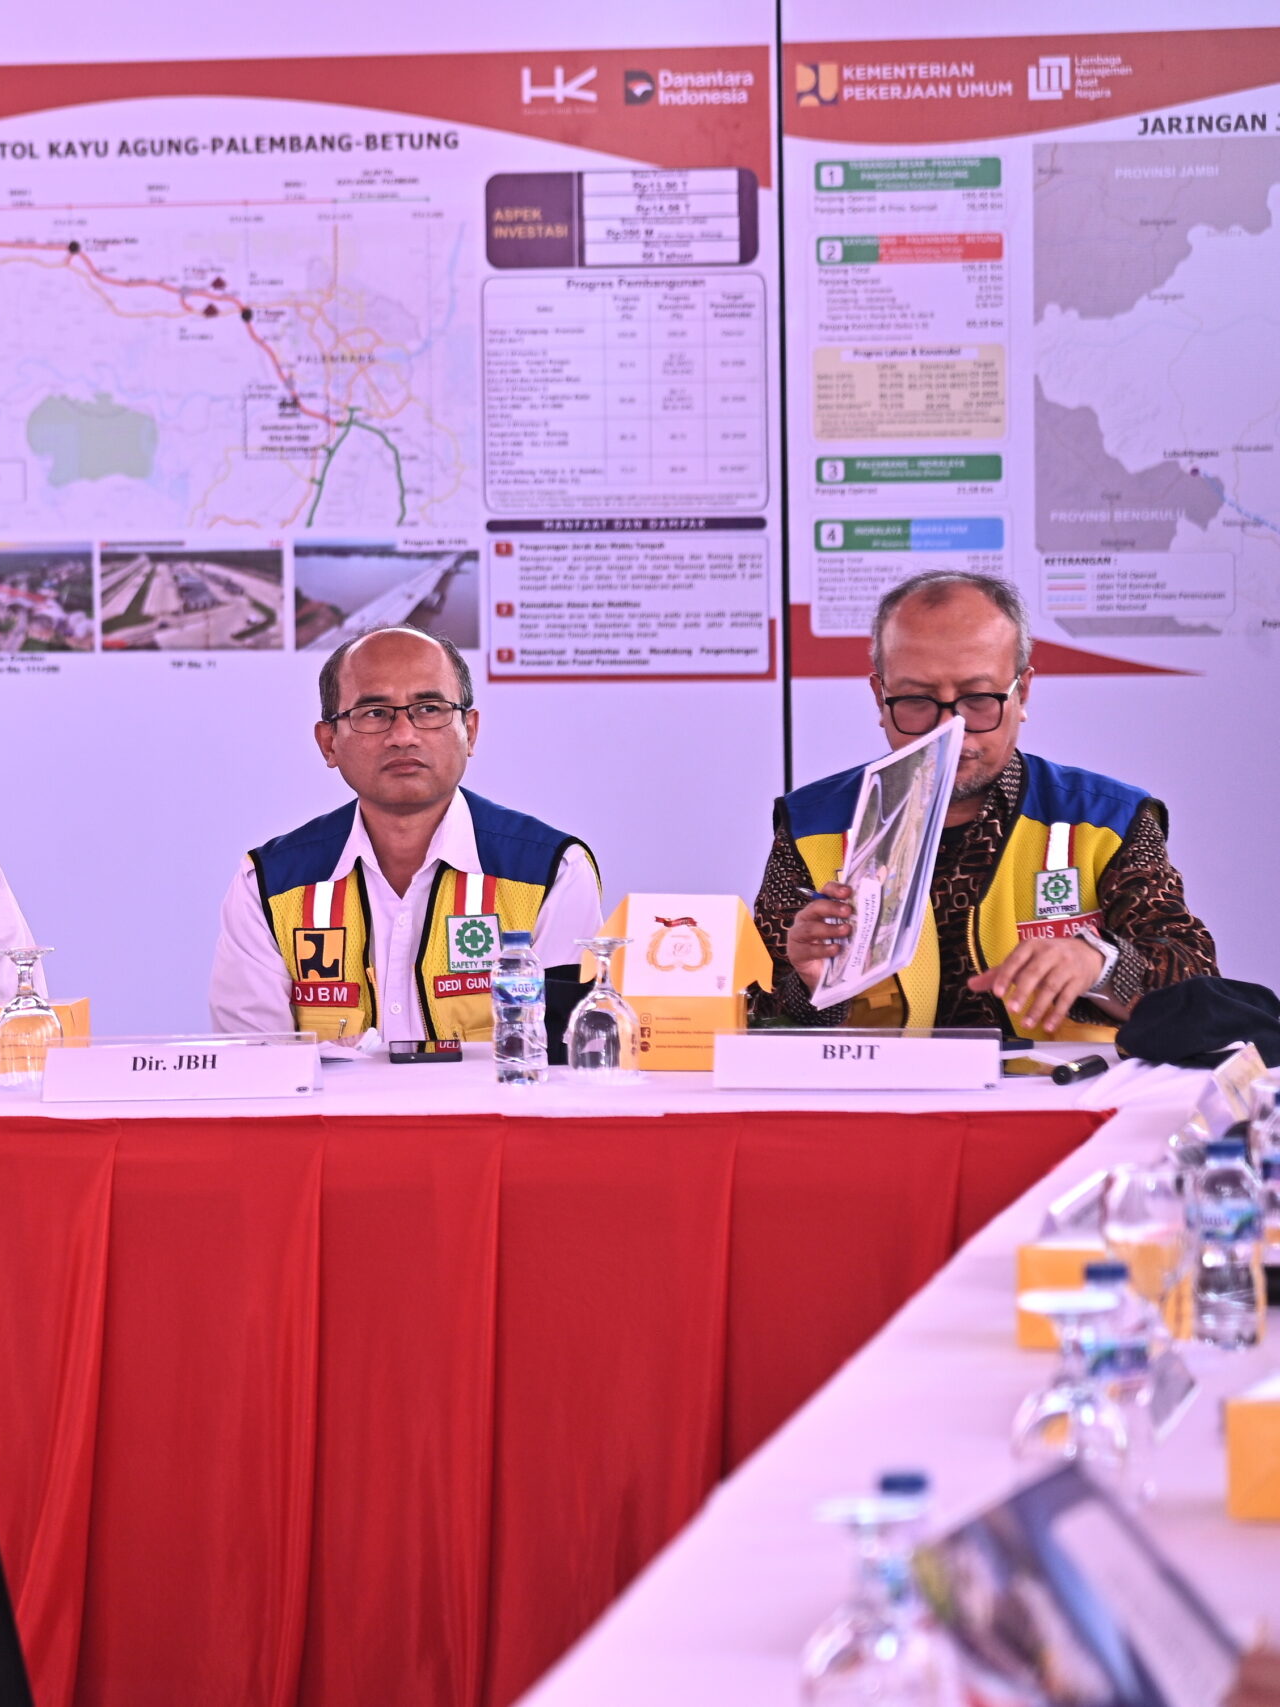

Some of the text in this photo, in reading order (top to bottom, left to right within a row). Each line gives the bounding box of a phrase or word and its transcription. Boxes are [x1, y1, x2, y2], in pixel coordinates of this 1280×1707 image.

[659, 70, 754, 87] Danantara
[843, 62, 975, 80] KEMENTERIAN
[522, 66, 597, 104] HK
[843, 81, 1013, 100] PEKERJAAN UMUM
[659, 88, 749, 105] Indonesia
[1138, 114, 1267, 136] JARINGAN
[49, 140, 110, 159] KAYU
[119, 132, 460, 157] AGUNG-PALEMBANG-BETUNG
[828, 169, 835, 185] 1
[1115, 166, 1219, 179] PROVINSI JAMBI
[494, 207, 542, 221] ASPEK
[494, 225, 568, 239] INVESTASI
[827, 245, 836, 260] 2
[828, 464, 838, 481] 3
[1050, 509, 1110, 523] PROVINSI
[826, 527, 837, 543] 4
[1044, 557, 1111, 567] KETERANGAN
[1039, 904, 1077, 915] SAFETY FIRST
[451, 961, 478, 969] SAFETY
[437, 978, 462, 993] DEDI
[511, 983, 536, 993] AQUA
[295, 986, 349, 1003] DJBM
[822, 1044, 880, 1061] BPJT
[132, 1054, 218, 1072] Dir. JBH
